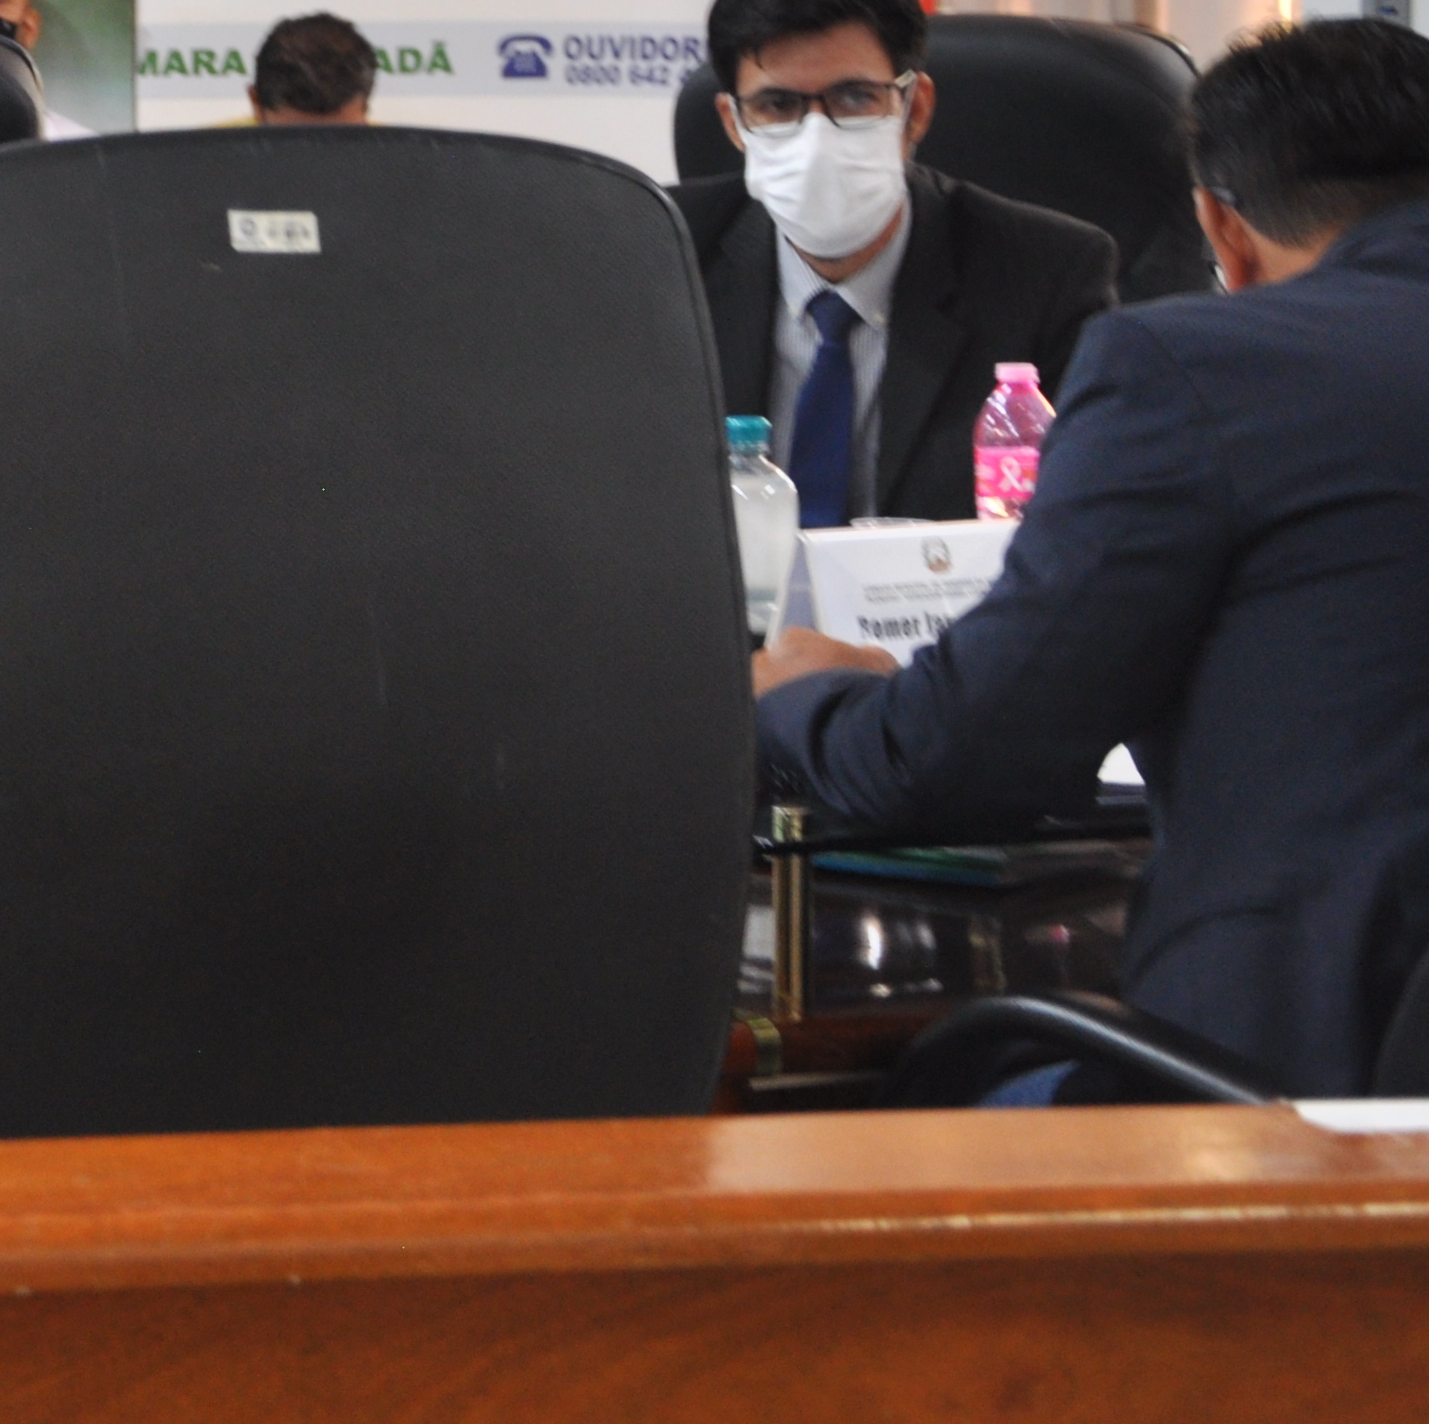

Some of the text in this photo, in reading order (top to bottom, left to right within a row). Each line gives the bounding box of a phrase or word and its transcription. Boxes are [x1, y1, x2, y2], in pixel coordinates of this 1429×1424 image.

[137, 40, 453, 76] MARA ADÃ
[563, 34, 705, 63] OUVIDOR
